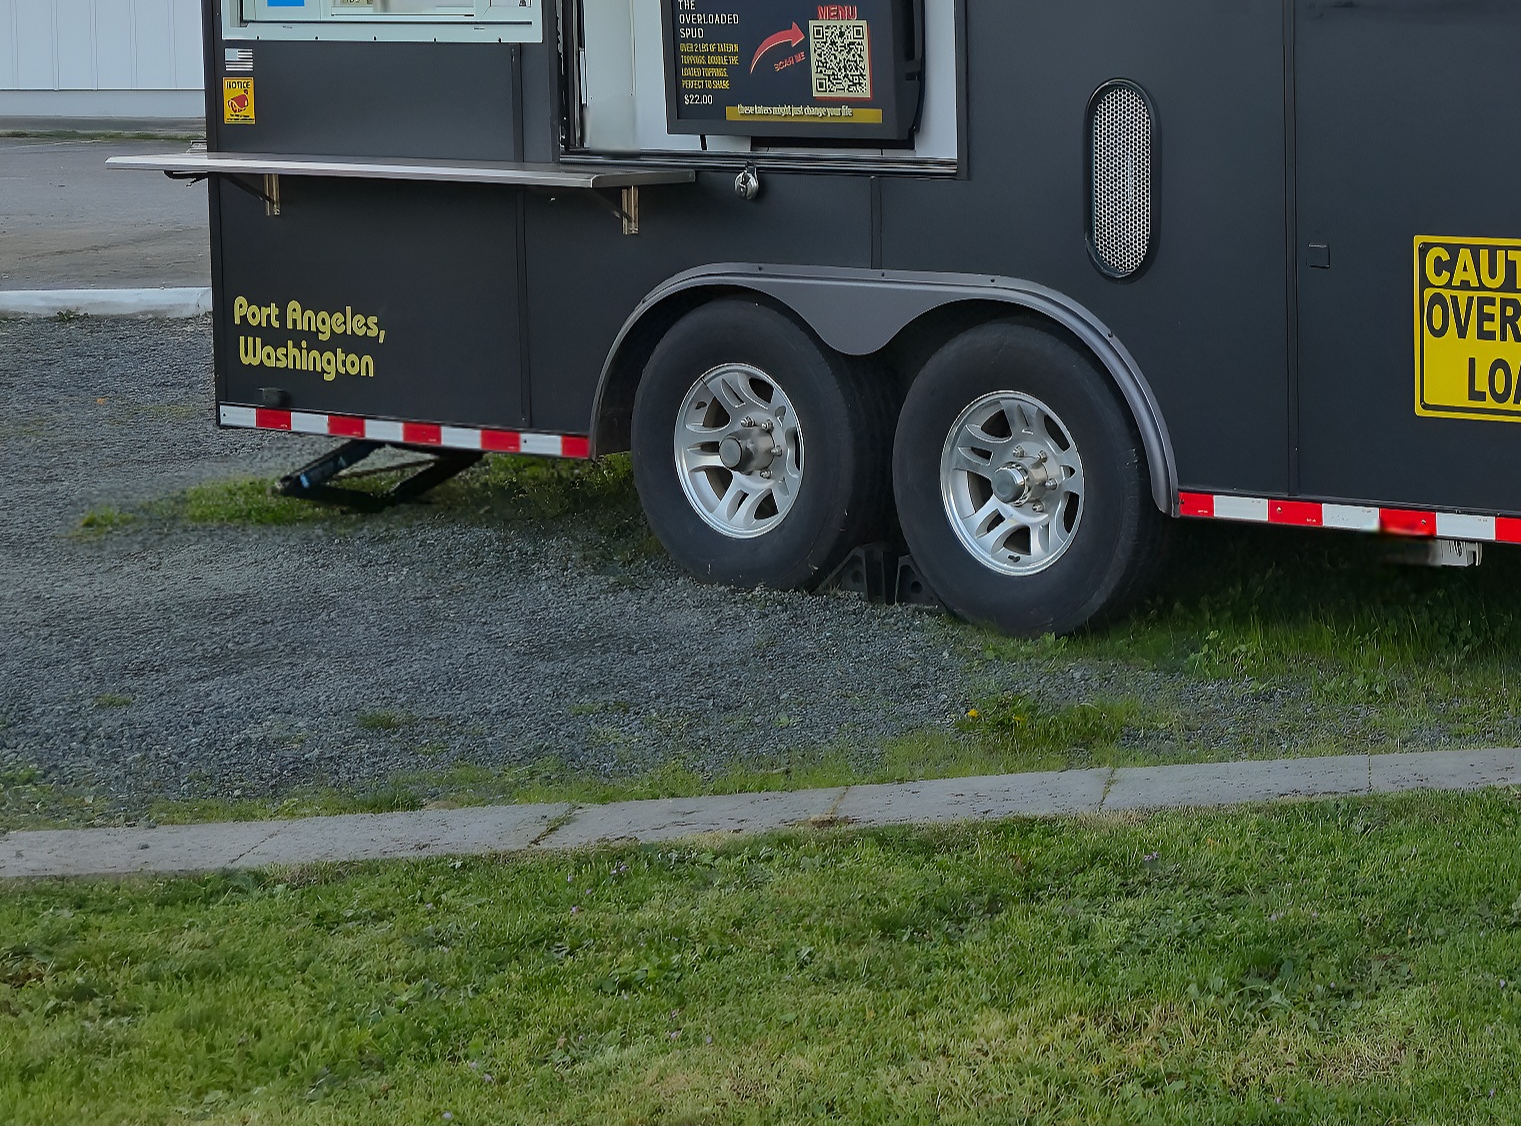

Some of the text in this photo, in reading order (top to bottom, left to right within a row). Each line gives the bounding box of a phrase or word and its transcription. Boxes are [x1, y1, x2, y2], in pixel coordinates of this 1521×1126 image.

[678, 0, 696, 10] THE
[817, 5, 857, 20] MENU
[679, 13, 739, 25] OVERLOADED
[680, 28, 704, 39] SPUD
[774, 56, 795, 72] SCAN
[226, 81, 251, 89] NOTICE
[684, 94, 713, 105] $22.00
[234, 295, 386, 344] Port Angeles,
[239, 335, 375, 381] Washington
